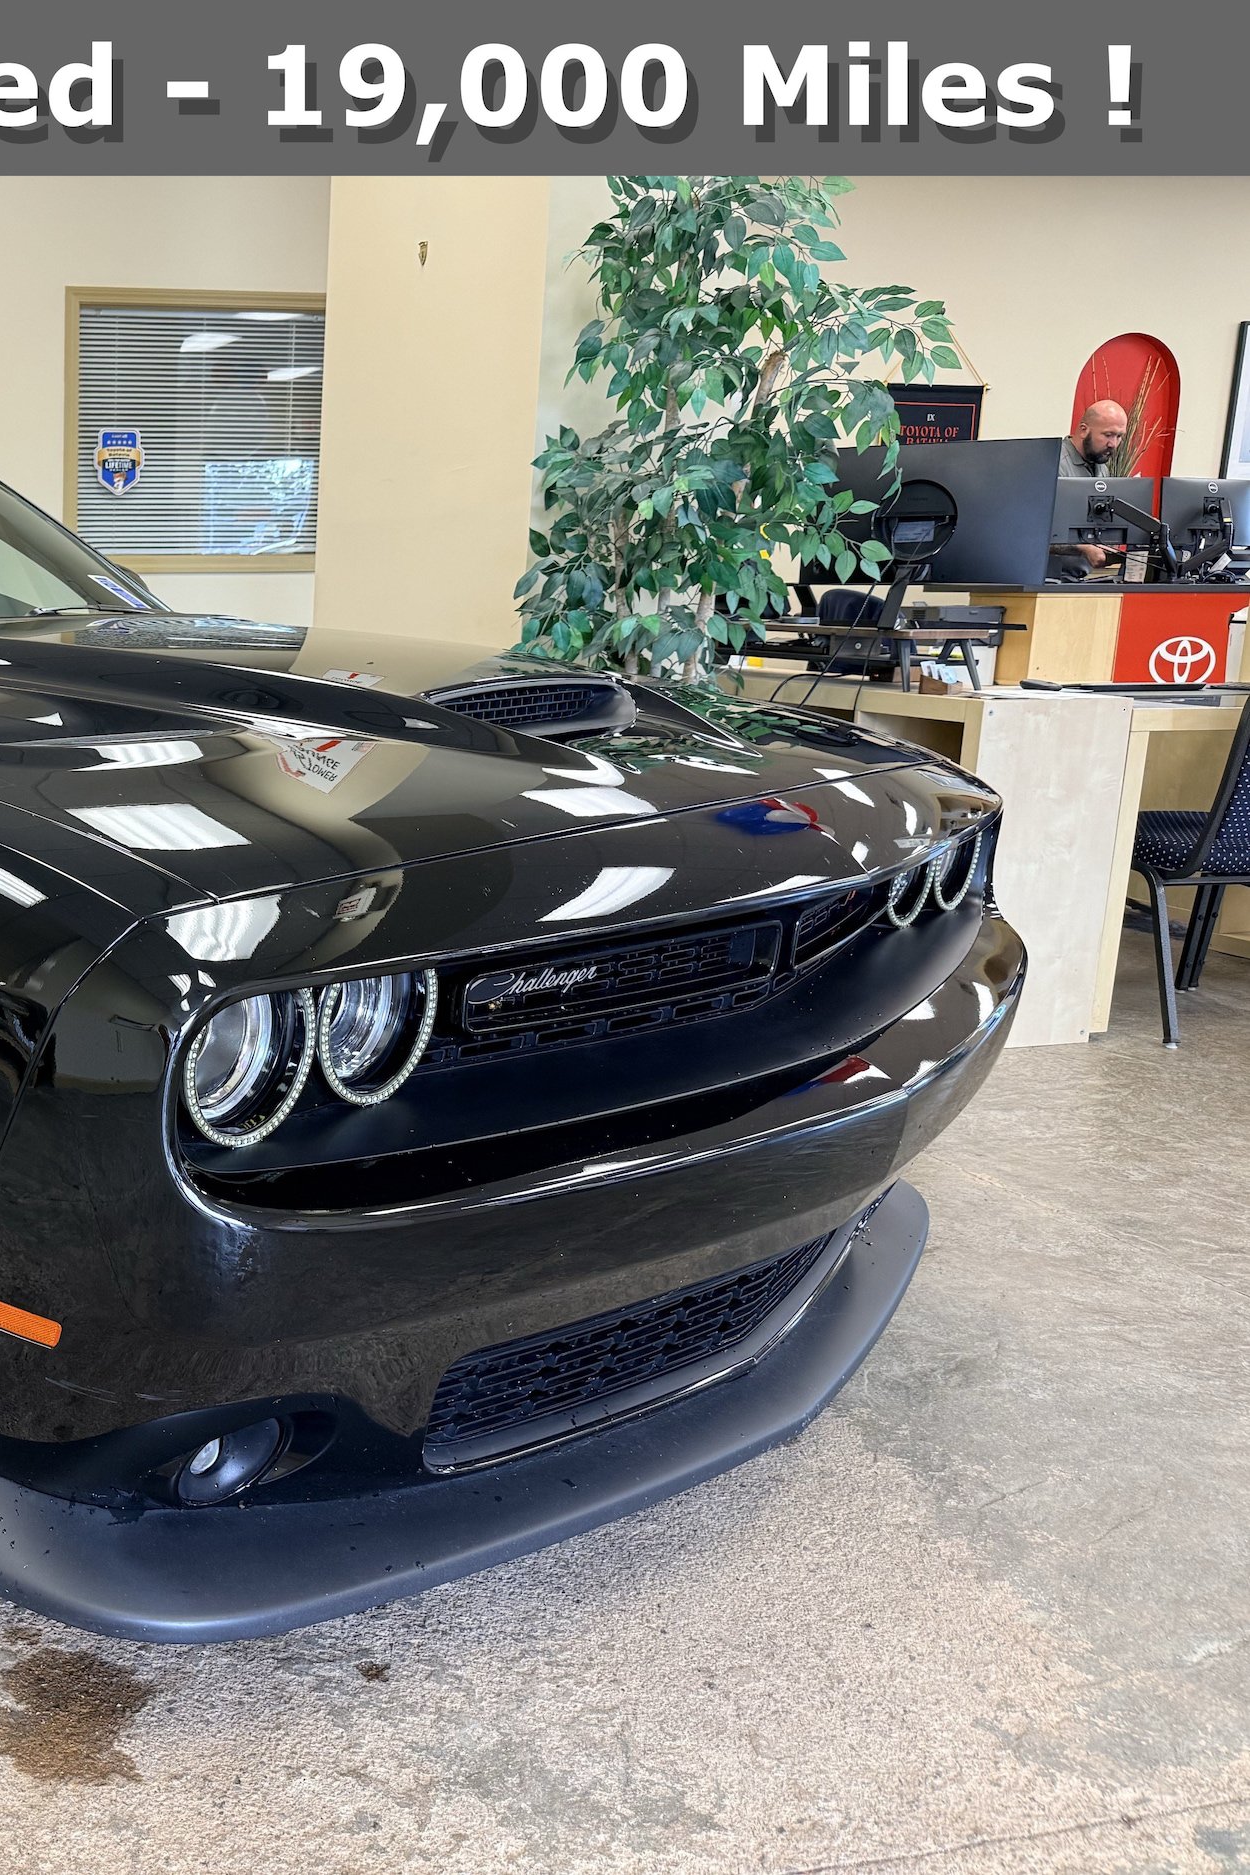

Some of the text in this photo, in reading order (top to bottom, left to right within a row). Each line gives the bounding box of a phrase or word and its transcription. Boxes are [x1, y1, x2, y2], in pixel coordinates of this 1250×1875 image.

[927, 414, 936, 422] IX
[900, 425, 959, 438] TOYOTA OF
[468, 966, 598, 1004] Challenger
